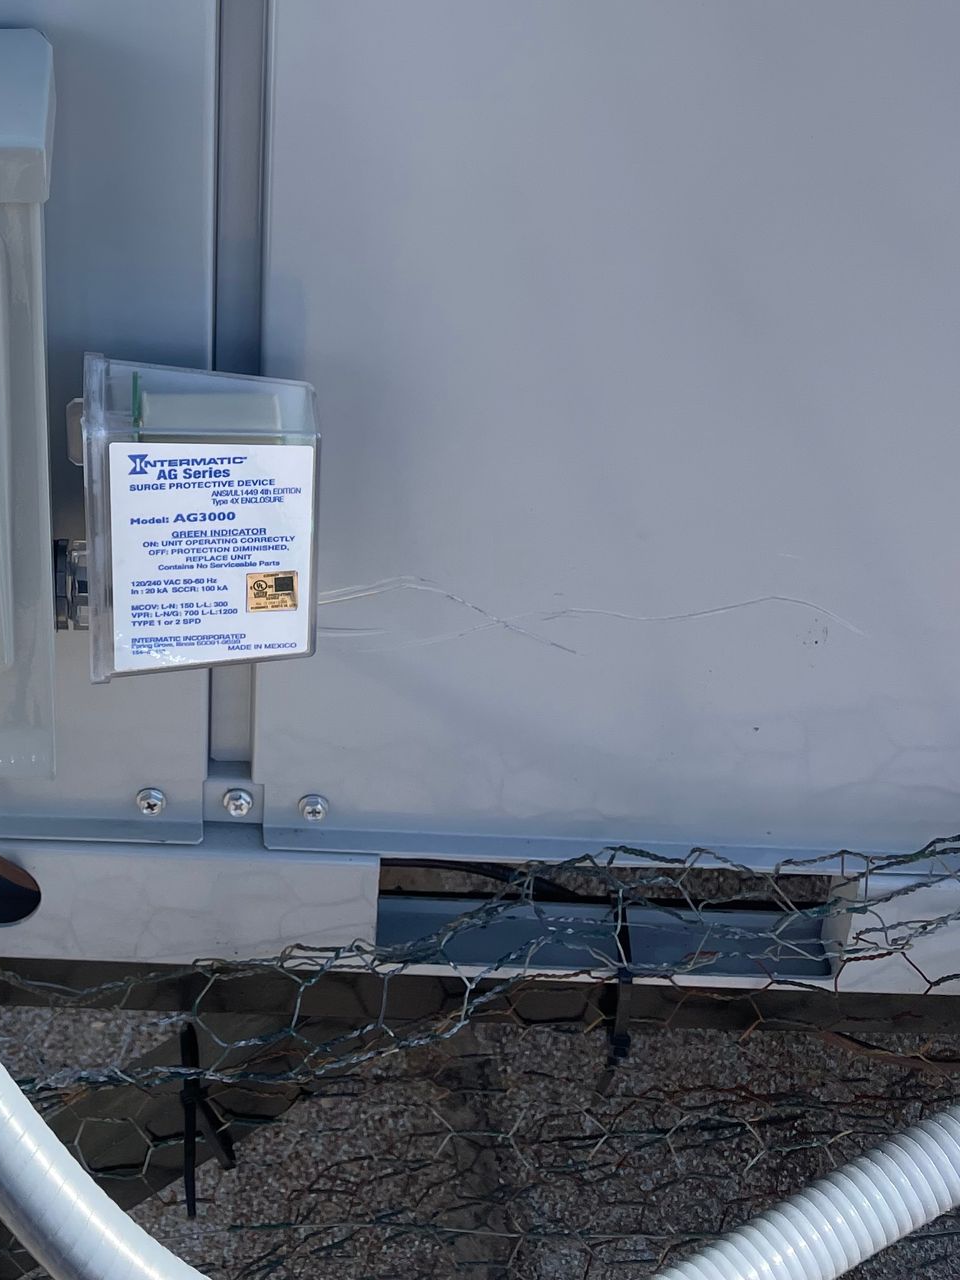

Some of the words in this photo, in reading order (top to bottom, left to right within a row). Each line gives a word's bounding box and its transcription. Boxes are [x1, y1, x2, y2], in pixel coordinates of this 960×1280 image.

[156, 469, 177, 480] AG
[183, 468, 230, 480] Series
[129, 483, 166, 492] SURGE
[169, 480, 234, 490] PROTECTIVE
[237, 478, 275, 487] DEVICE
[273, 487, 301, 495] EDITION
[212, 498, 228, 507] Type
[230, 497, 239, 505] 4X
[241, 496, 284, 505] ENCLOSURE
[130, 516, 169, 525] Model:
[173, 511, 236, 523] AG3000
[171, 530, 208, 539] GREEN
[210, 528, 267, 537] INDICATOR
[161, 539, 182, 547] UNIT
[185, 538, 238, 546] OPERATING
[240, 535, 295, 544] CORRECTLY
[171, 546, 230, 555] PROTECTION
[185, 554, 228, 562] REPLACE
[230, 553, 252, 561] UNIT
[210, 561, 257, 569] Serviceable
[131, 579, 162, 587] 120/240
[163, 578, 181, 586] VAC
[182, 577, 205, 586] 50-60
[145, 587, 156, 595] 20
[157, 586, 168, 594] kA
[172, 586, 199, 594] SCCR:
[201, 585, 215, 593] 100
[217, 584, 228, 592] kA
[131, 604, 159, 612] MCOV:
[180, 602, 194, 610] 150
[213, 600, 228, 608] 300
[131, 611, 153, 619] VPR:
[184, 609, 199, 617] 700
[182, 618, 201, 626] SPD
[131, 635, 181, 644] INTERMATIC
[182, 633, 246, 642] INCORPORATED
[264, 642, 297, 651] MEXICO
